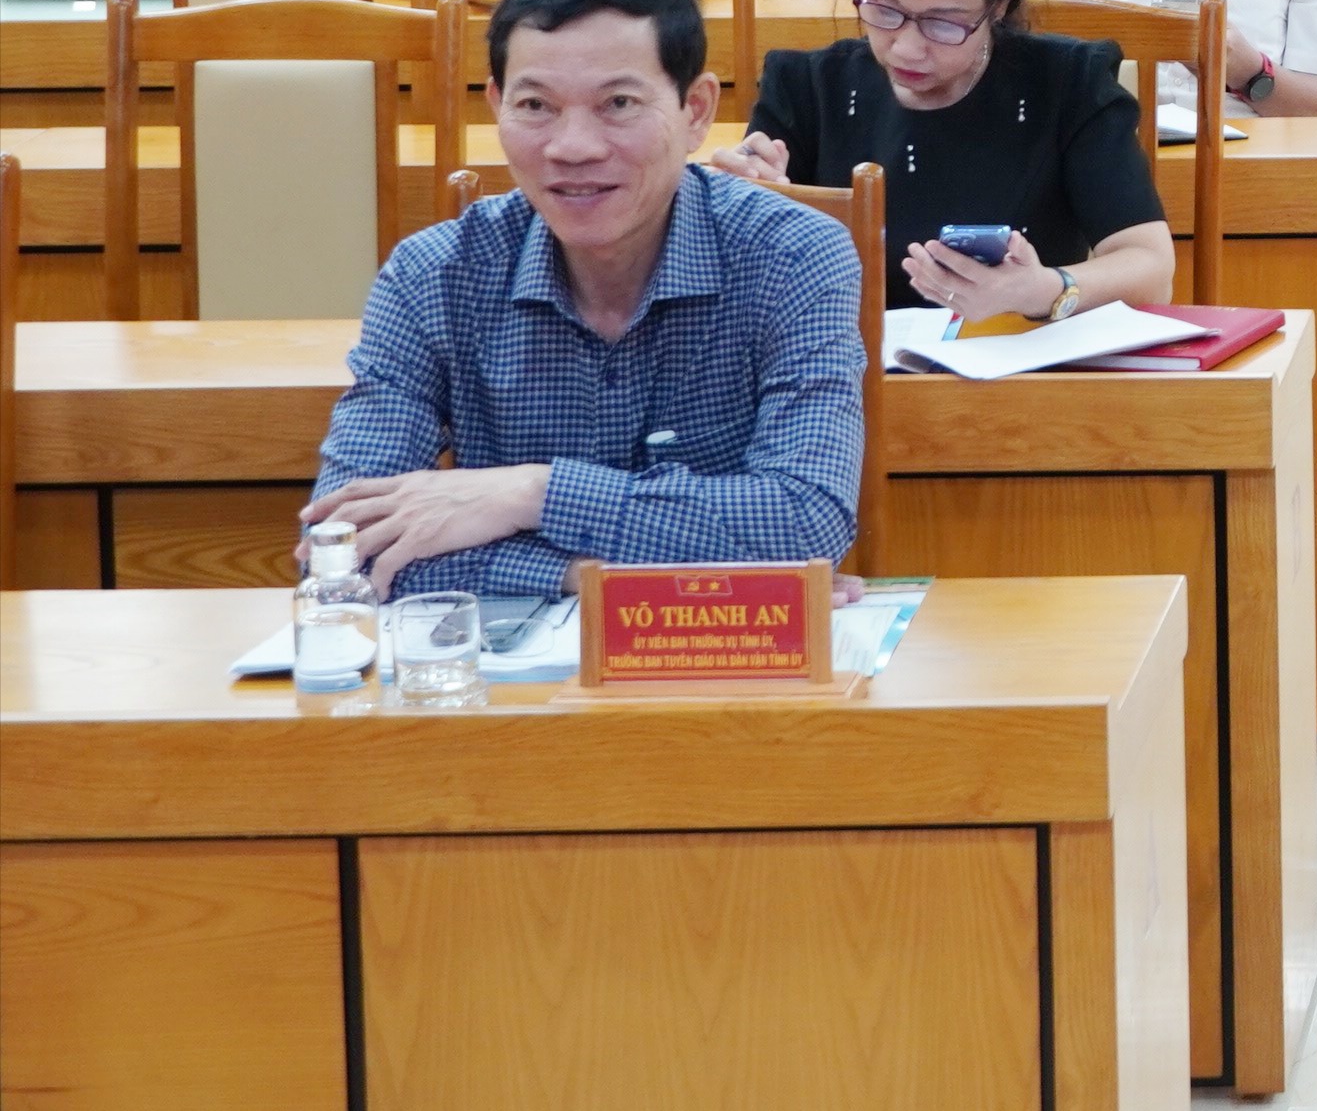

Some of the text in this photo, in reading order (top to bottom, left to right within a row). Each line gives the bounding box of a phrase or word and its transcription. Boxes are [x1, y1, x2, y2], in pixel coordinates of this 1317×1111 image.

[618, 601, 790, 628] VÕ THANH AN
